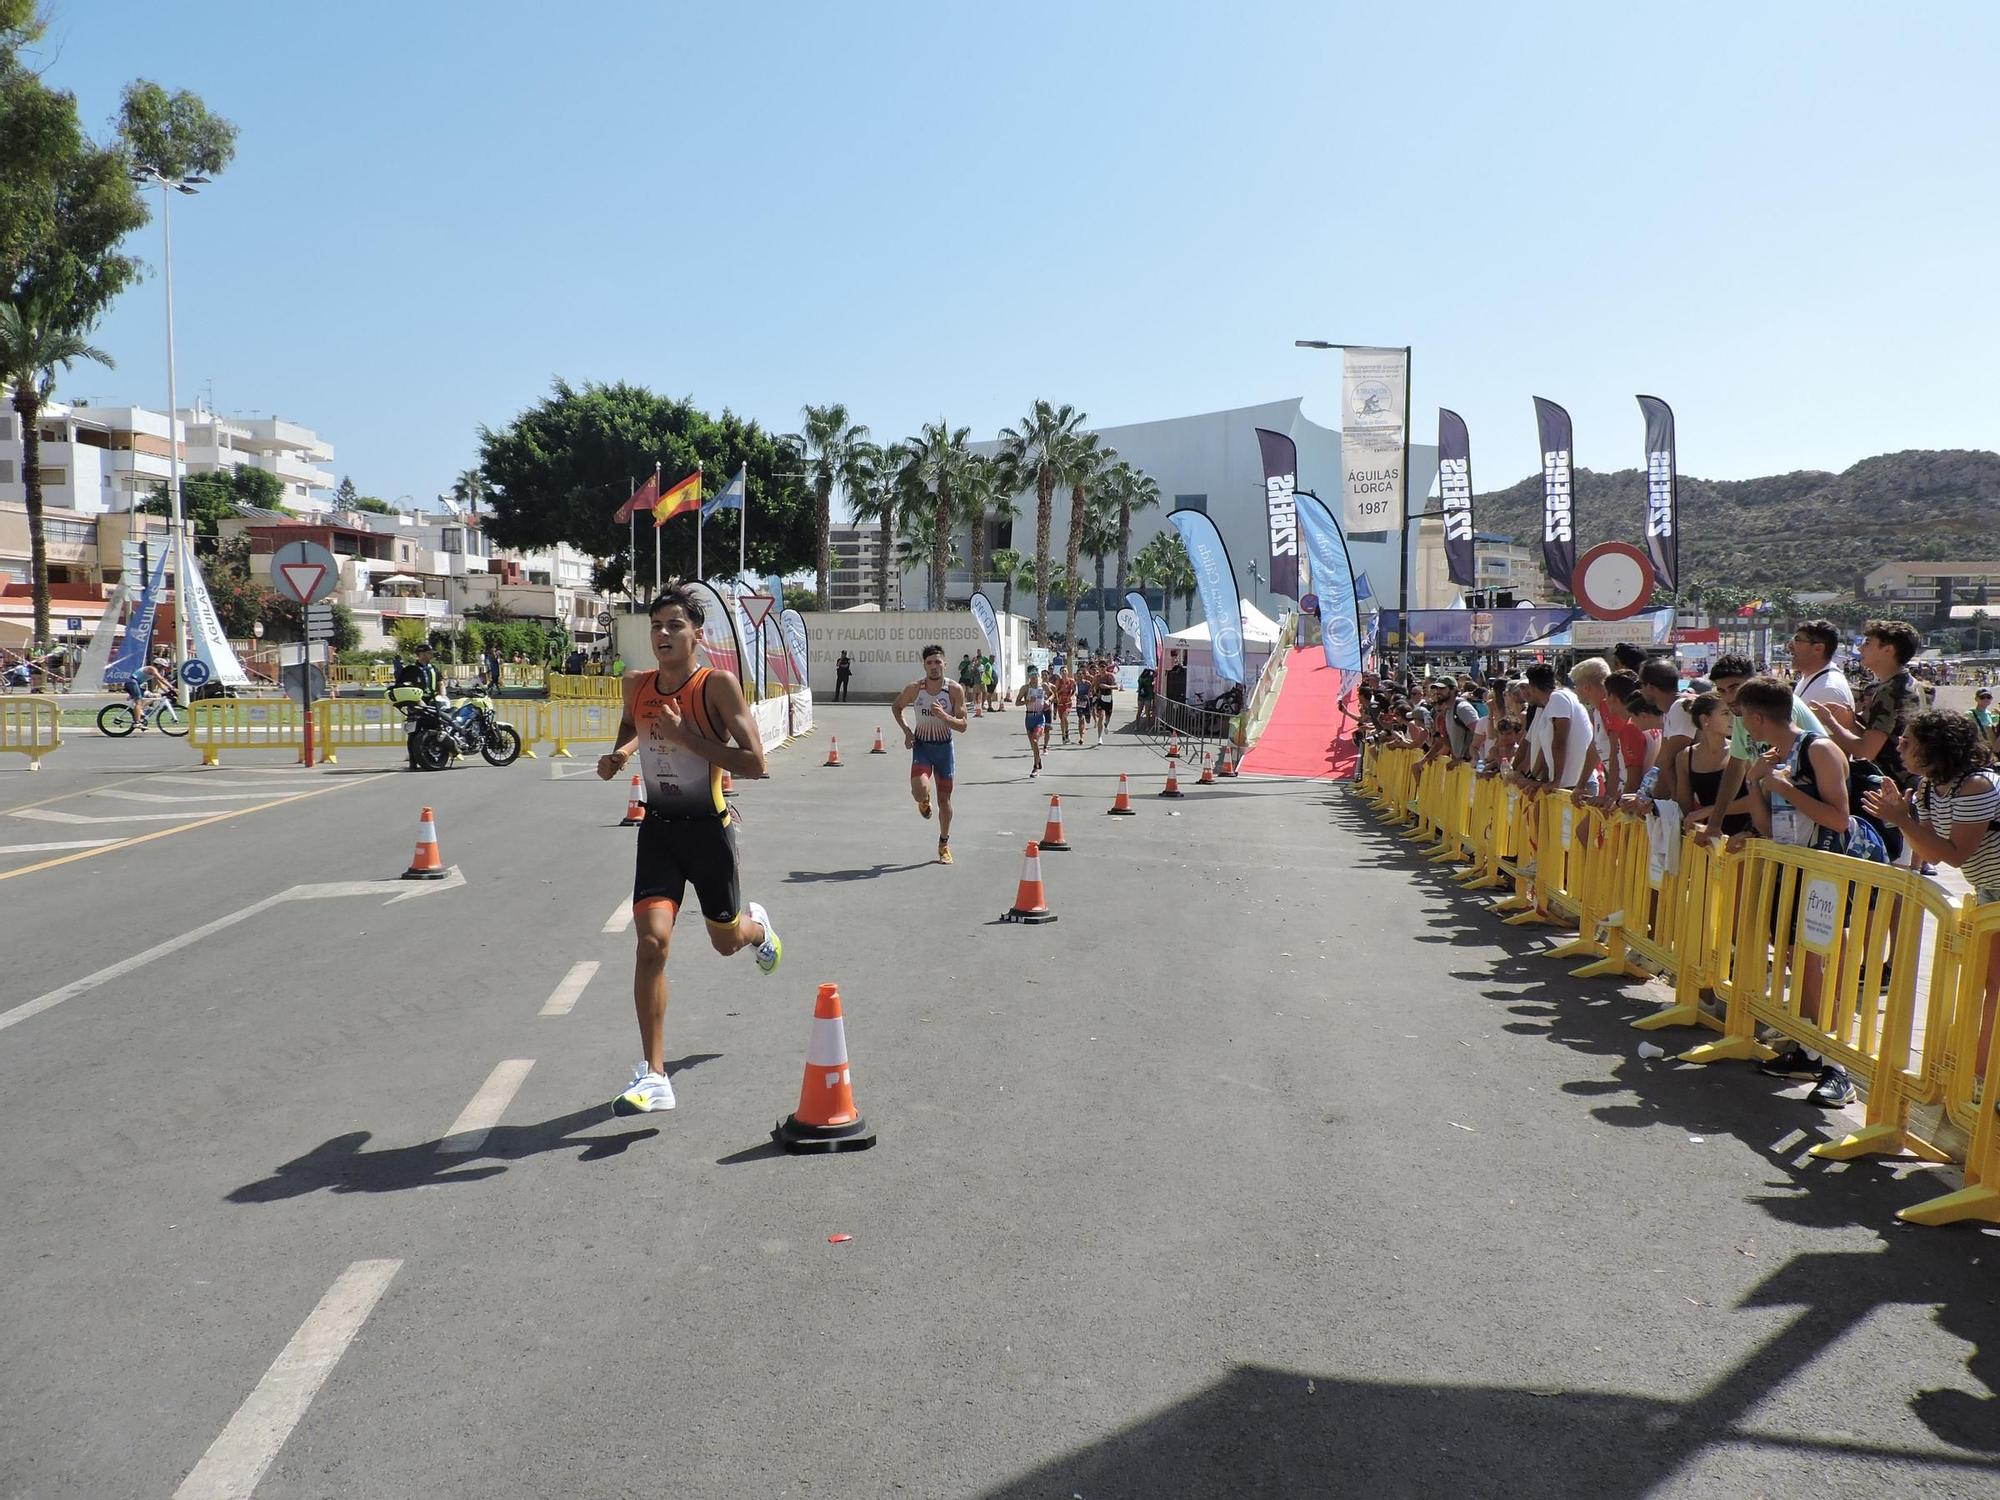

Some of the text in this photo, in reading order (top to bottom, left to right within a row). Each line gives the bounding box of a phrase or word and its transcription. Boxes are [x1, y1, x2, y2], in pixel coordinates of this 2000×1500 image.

[1348, 468, 1399, 482] ÁGUILAS
[1353, 481, 1393, 494] LORCA
[1358, 501, 1389, 515] 1987
[71, 620, 78, 629] P
[826, 628, 834, 641] Y
[837, 628, 886, 641] PALACIO
[890, 627, 905, 641] DE
[908, 627, 979, 641] CONGRESOS
[859, 647, 892, 663] DOÑA
[896, 650, 923, 663] ELEN
[1807, 889, 1834, 914] ftrm
